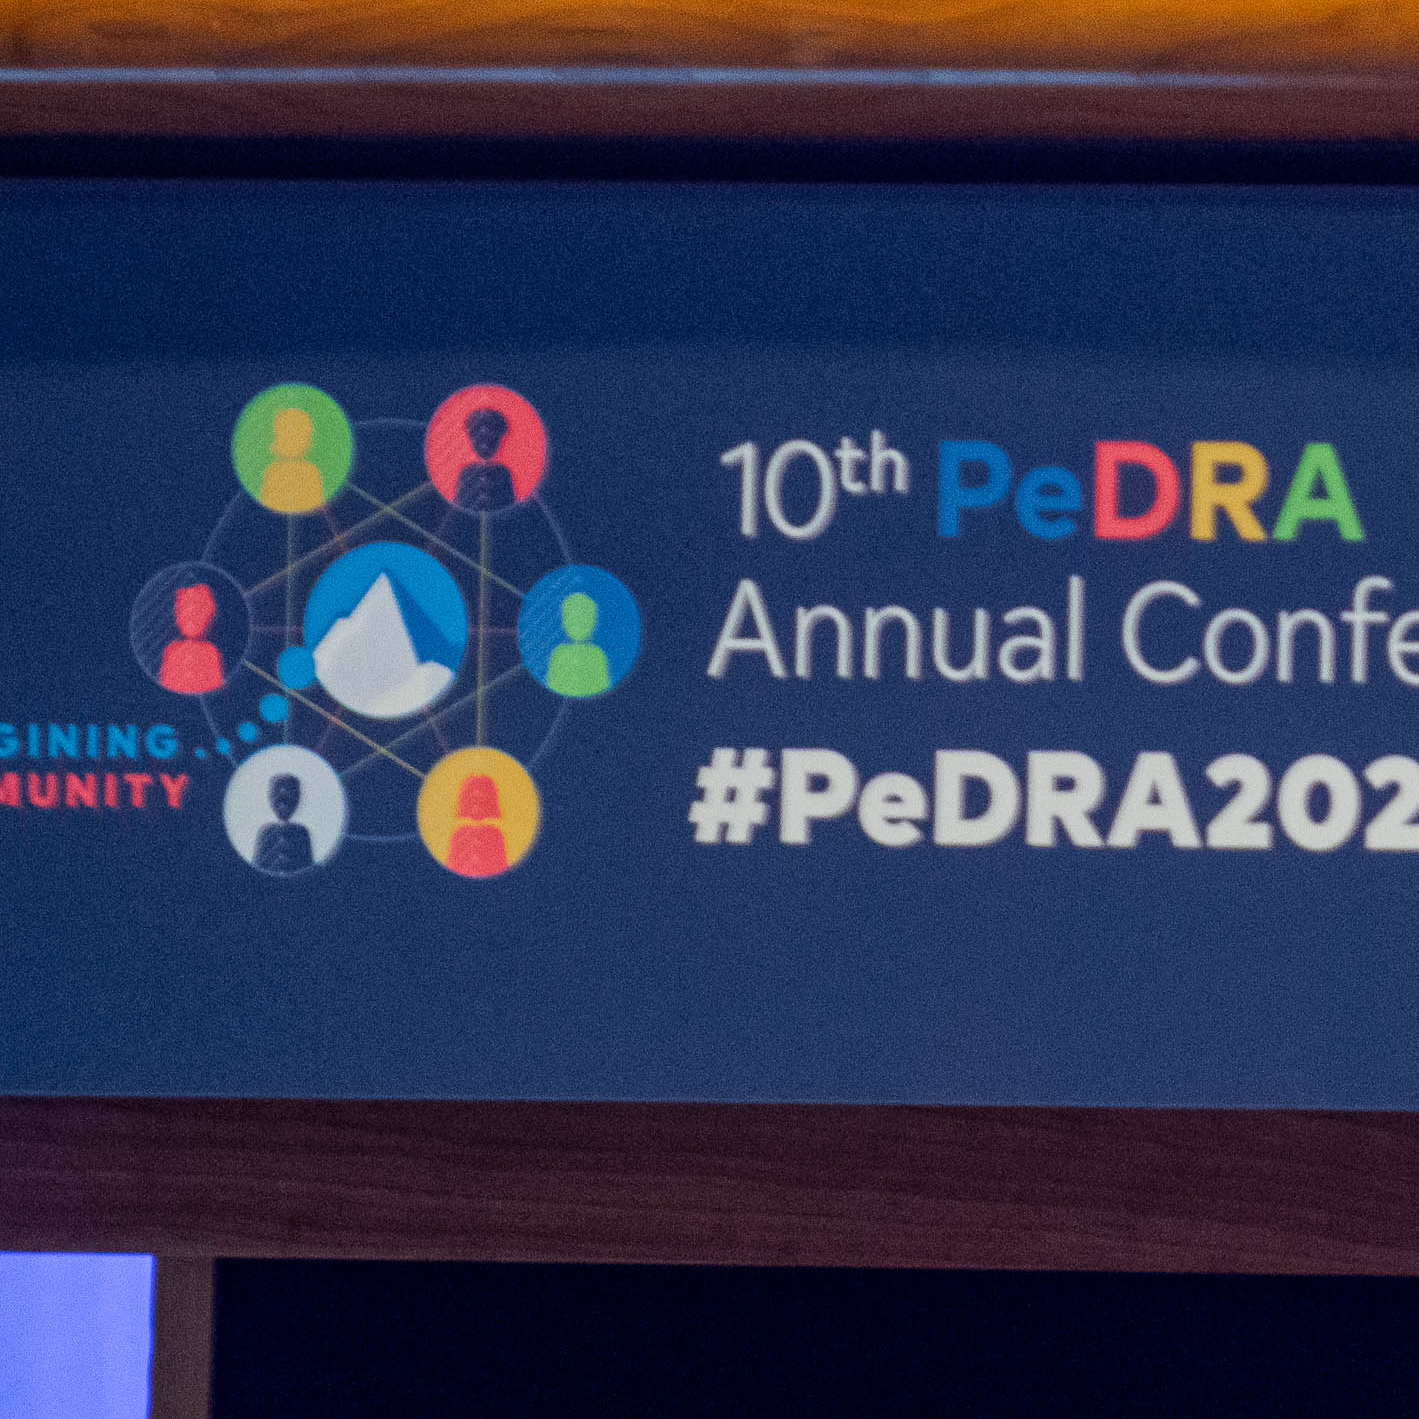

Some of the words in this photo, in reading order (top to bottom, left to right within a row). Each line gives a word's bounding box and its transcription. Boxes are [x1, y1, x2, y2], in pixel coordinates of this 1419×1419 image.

[719, 428, 911, 540] 10th
[938, 438, 1366, 543] PeDRA
[706, 575, 1085, 684] Annual
